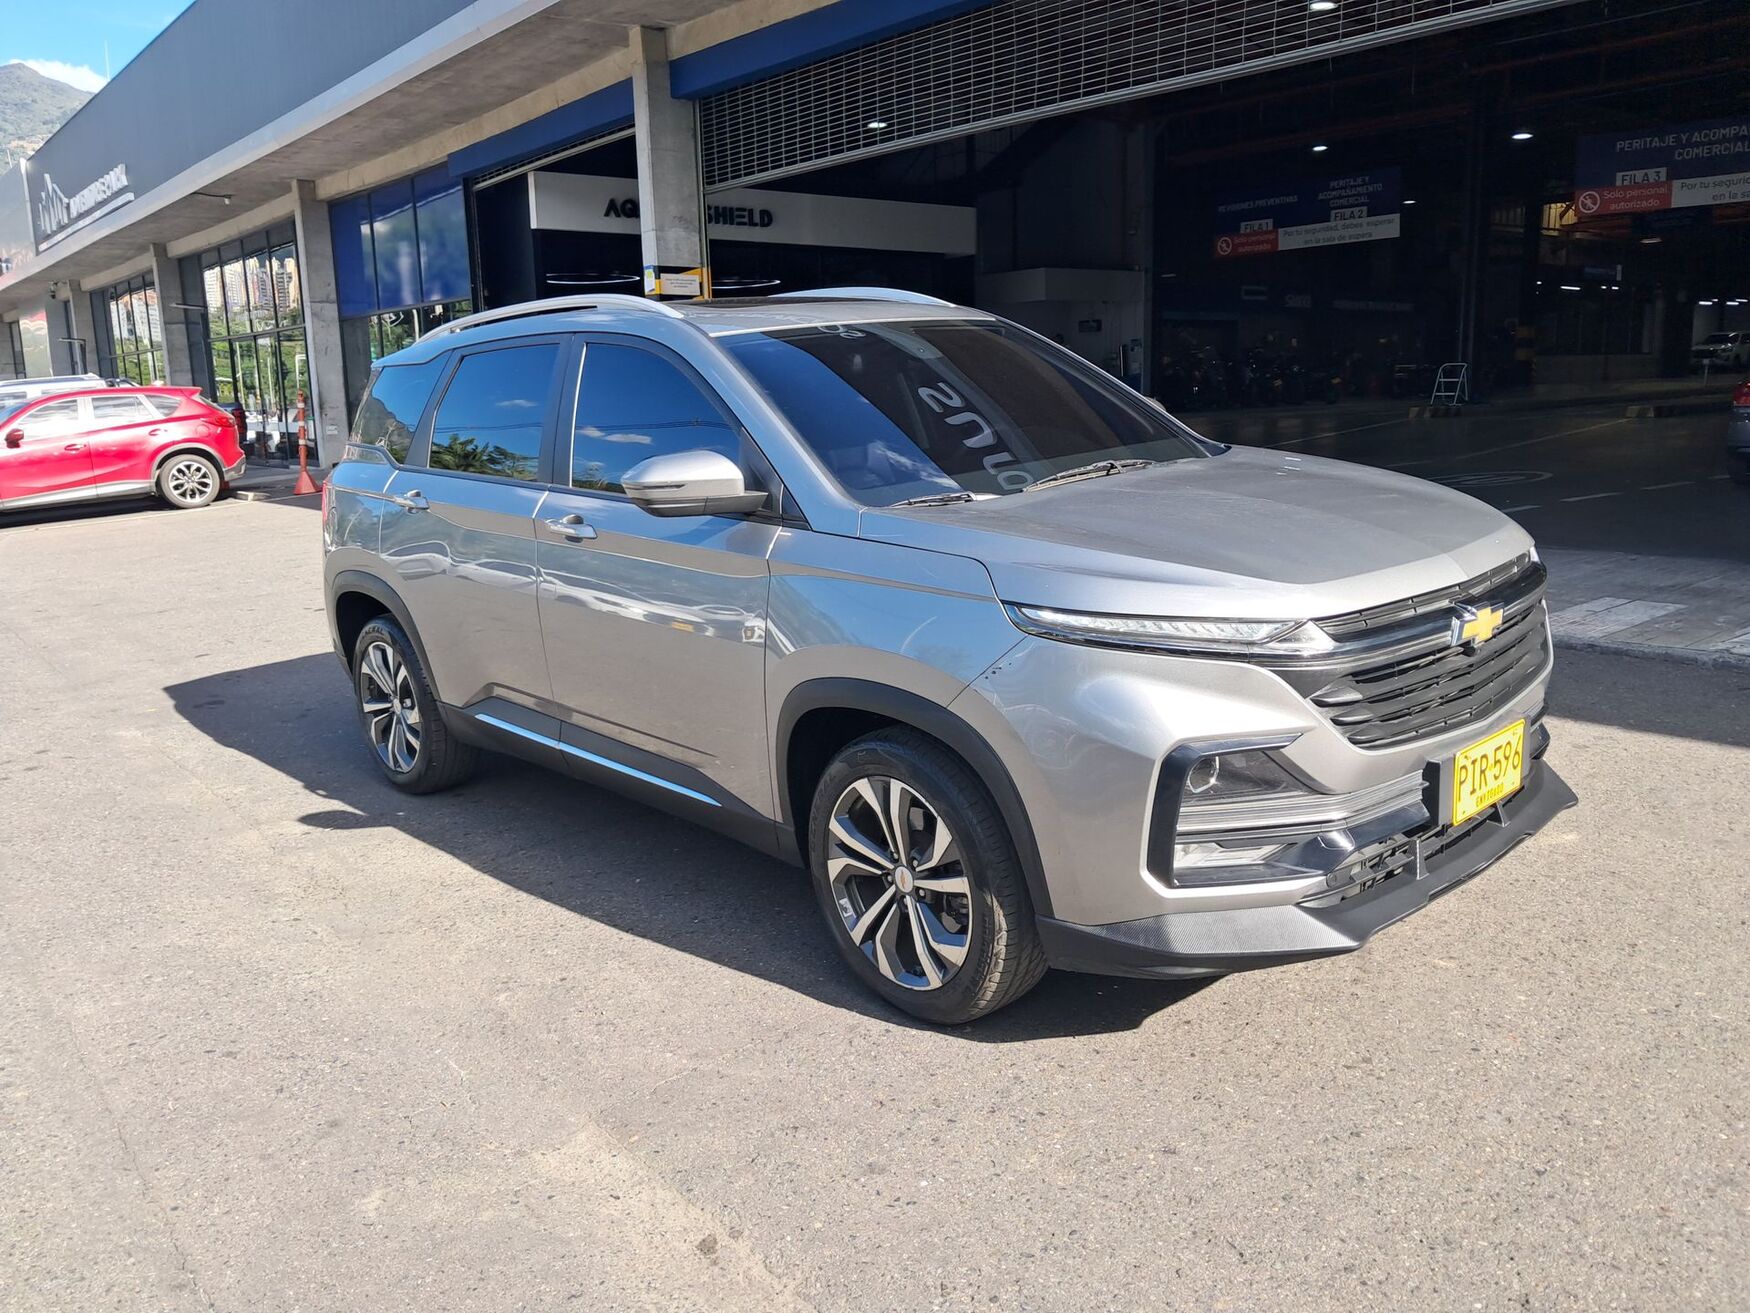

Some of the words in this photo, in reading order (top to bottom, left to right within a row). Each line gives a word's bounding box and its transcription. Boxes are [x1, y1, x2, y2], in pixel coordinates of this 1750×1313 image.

[1616, 133, 1677, 152] PERITAJE
[1679, 131, 1691, 144] Y
[1675, 141, 1750, 161] COMERCIAL
[1621, 172, 1650, 185] FILA
[1653, 170, 1662, 182] 3
[1681, 181, 1697, 192] Por
[1699, 180, 1709, 189] tu
[1626, 187, 1668, 199] personal
[1712, 192, 1726, 201] en
[1329, 195, 1370, 207] COMERCIAL
[1609, 199, 1660, 210] autorizado
[1334, 210, 1356, 221] FILA
[1357, 209, 1364, 219] 2
